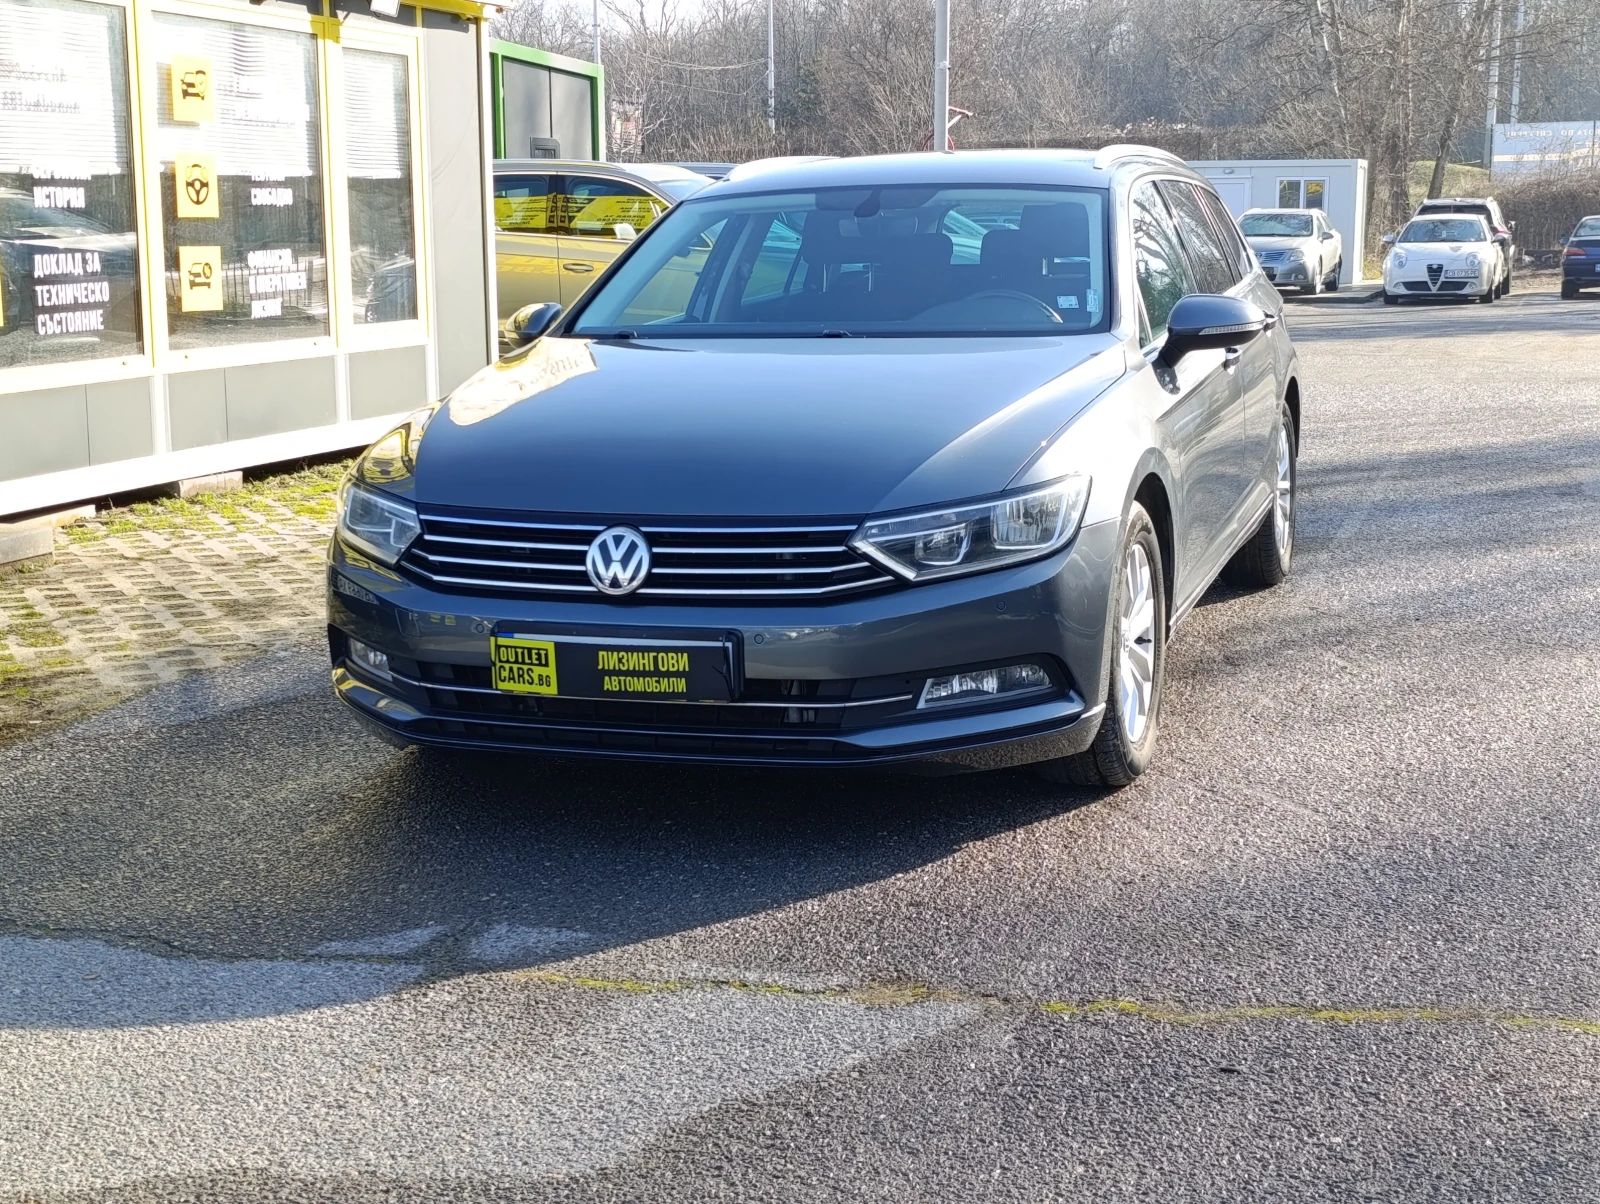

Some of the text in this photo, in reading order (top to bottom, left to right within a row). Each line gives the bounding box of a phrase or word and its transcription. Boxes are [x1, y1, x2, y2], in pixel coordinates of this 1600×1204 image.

[33, 186, 86, 208] ИСТОРИЯ
[33, 252, 102, 278] ДОКЛАД ЗА
[35, 281, 110, 307] ТЕХНИЧЕСКО
[37, 309, 105, 336] СЪСТОЯНИЕ
[499, 647, 547, 665] OUTLET
[597, 651, 689, 672] ЛИЗИНГОВИ
[498, 665, 552, 688] CARS.BG
[603, 676, 687, 693] АВТОМОБИЛИ
